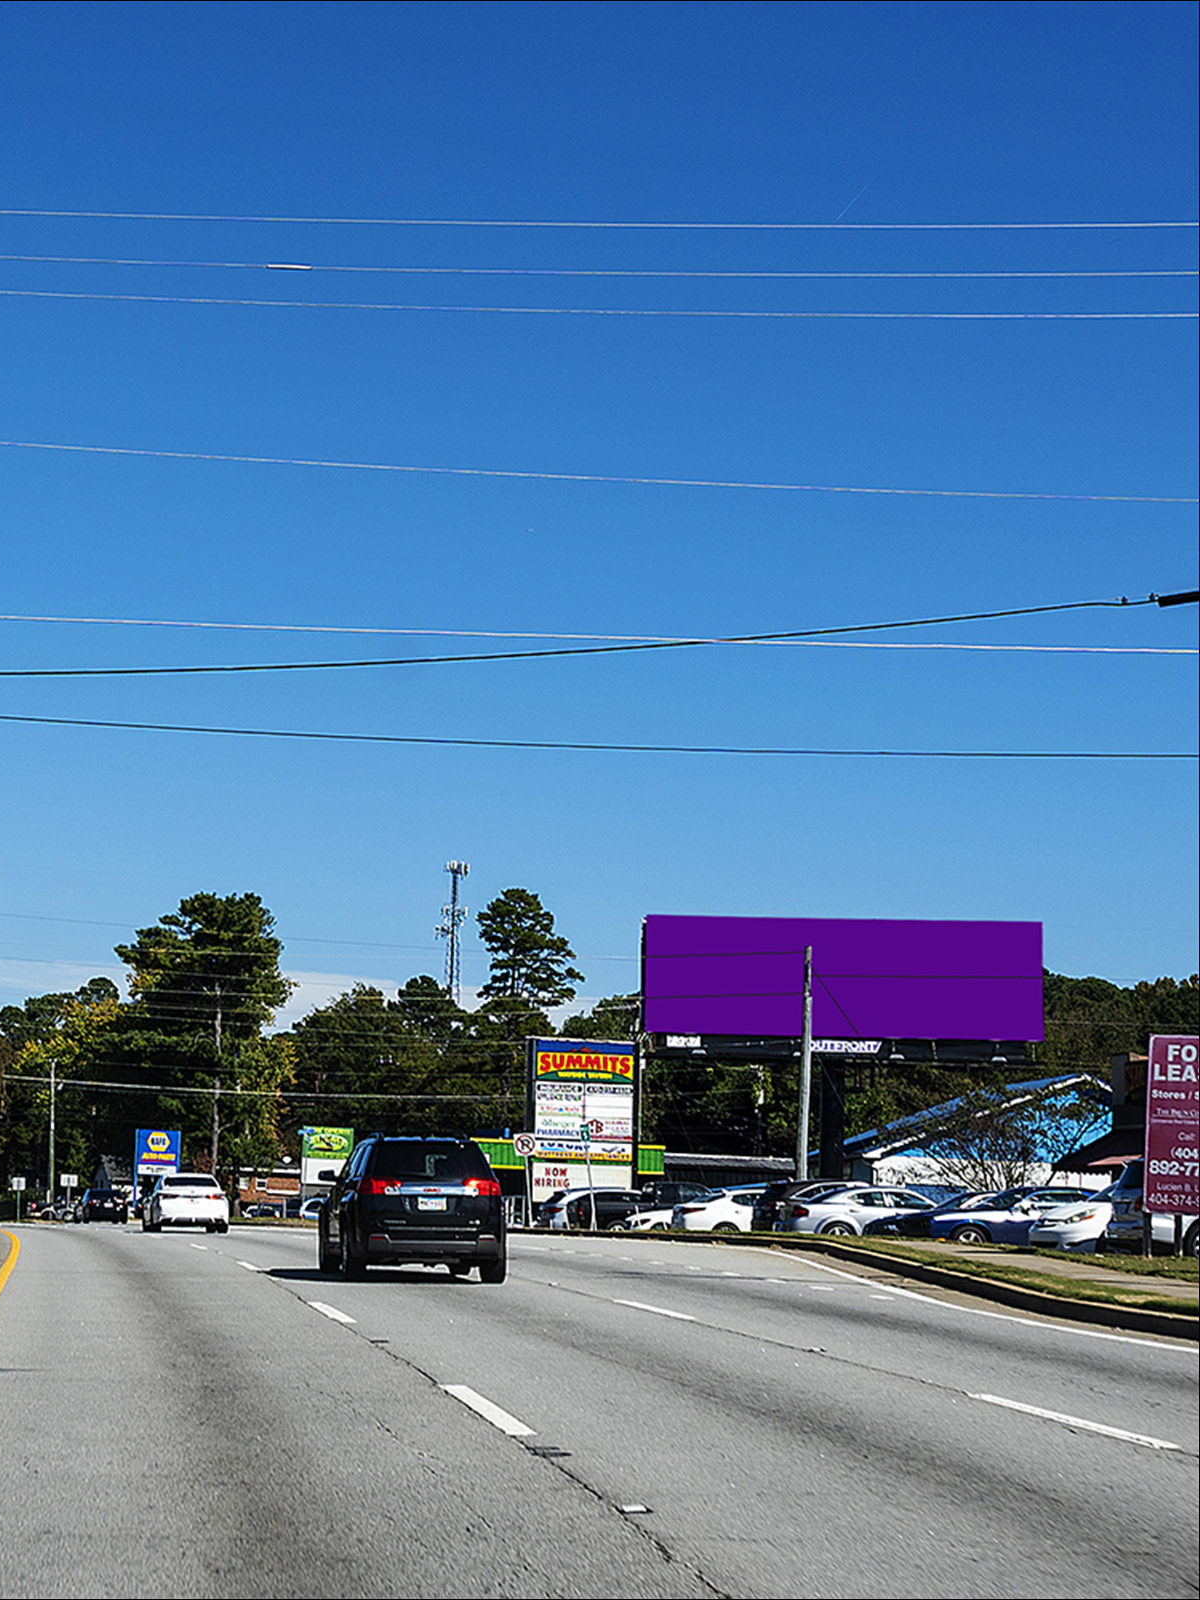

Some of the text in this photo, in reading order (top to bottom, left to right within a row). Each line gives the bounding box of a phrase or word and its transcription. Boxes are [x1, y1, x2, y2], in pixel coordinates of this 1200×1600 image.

[1168, 1045, 1199, 1062] FO
[540, 1053, 631, 1074] SUMMITS
[1154, 1064, 1199, 1082] LEA
[1152, 1089, 1186, 1099] Stores
[537, 1128, 580, 1137] PHARMACY
[544, 1167, 568, 1177] NOW
[534, 1178, 570, 1188] HIRING
